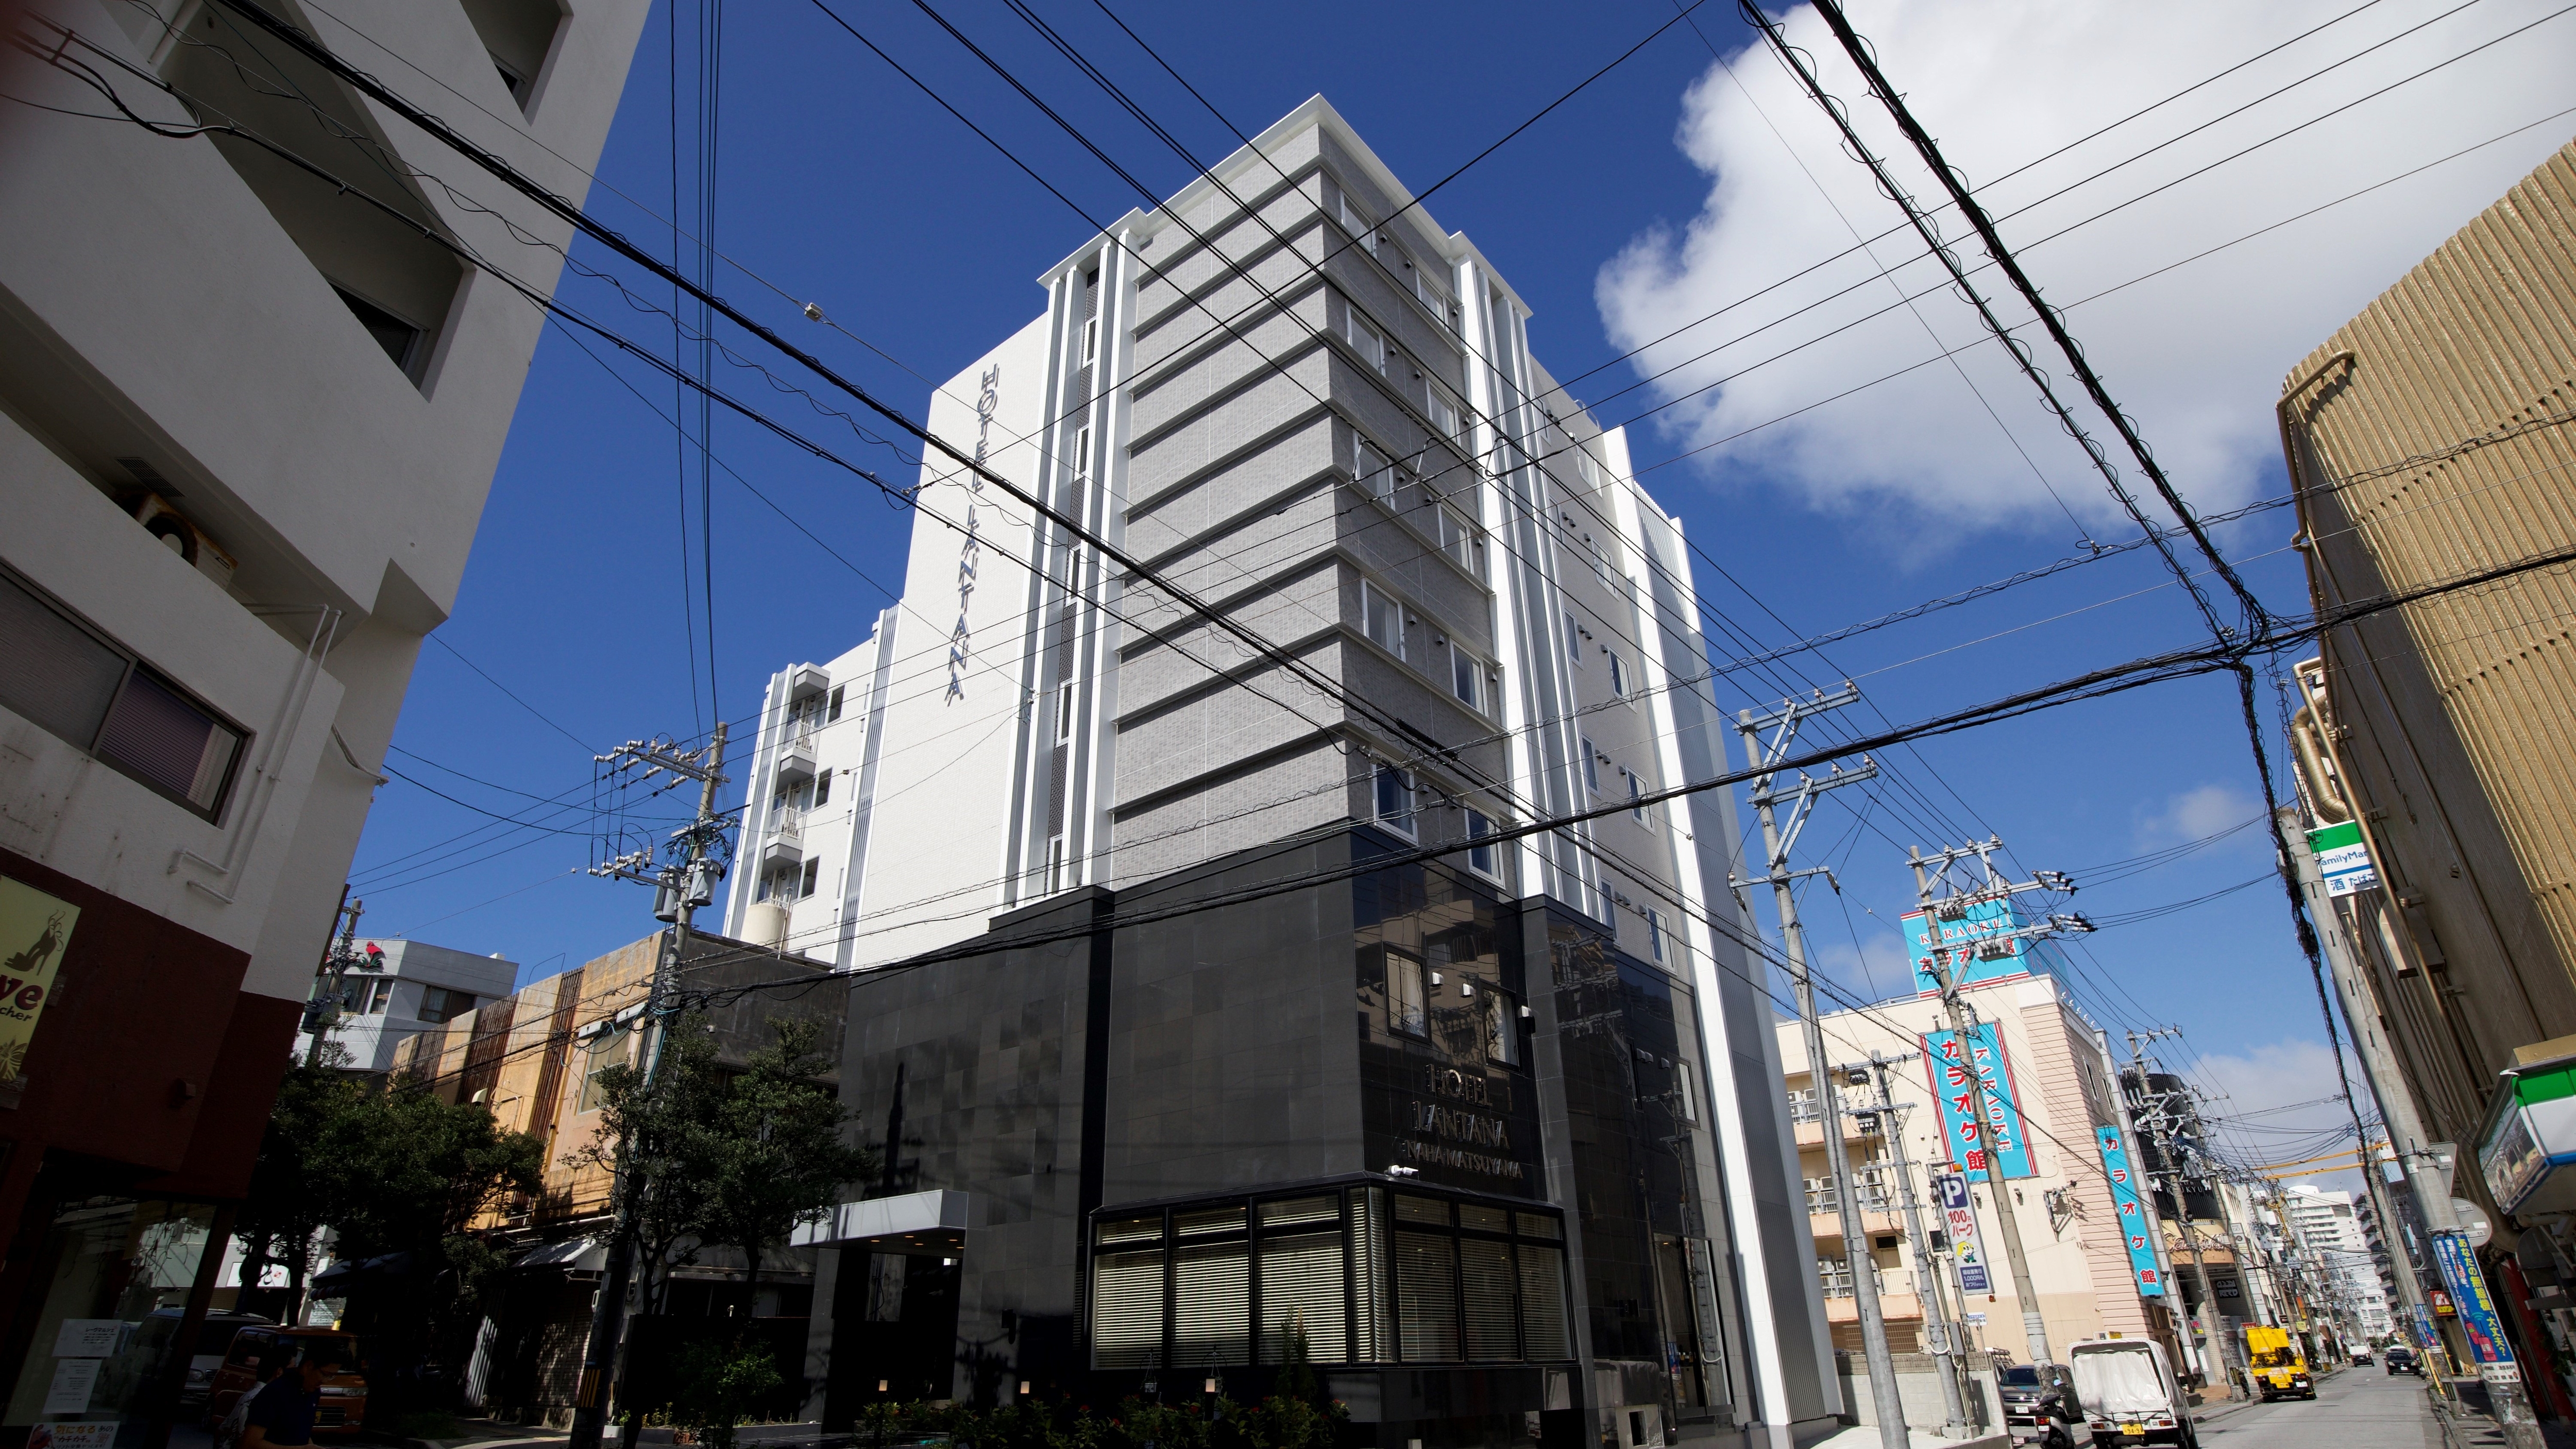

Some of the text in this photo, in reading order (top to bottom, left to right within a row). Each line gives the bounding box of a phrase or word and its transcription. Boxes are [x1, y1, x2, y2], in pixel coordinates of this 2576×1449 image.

[944, 363, 999, 707] HOTEL LANTANA
[2330, 873, 2378, 891] 酒 たばこ
[1920, 918, 2003, 944] KRAOKE
[1423, 1064, 1493, 1107] HOTEL
[1942, 1039, 1987, 1171] カラオケ館
[1975, 1047, 2012, 1152] KARAOKE
[1411, 1100, 1511, 1149] LANTANA
[1403, 1140, 1523, 1179] NAHA MATSUYAMA
[1943, 1180, 1962, 1205] P
[2105, 1137, 2157, 1284] カラオケ館
[1948, 1209, 1972, 1223] 100円
[1953, 1223, 1973, 1237] パーク
[55, 1425, 95, 1435] 気になる
